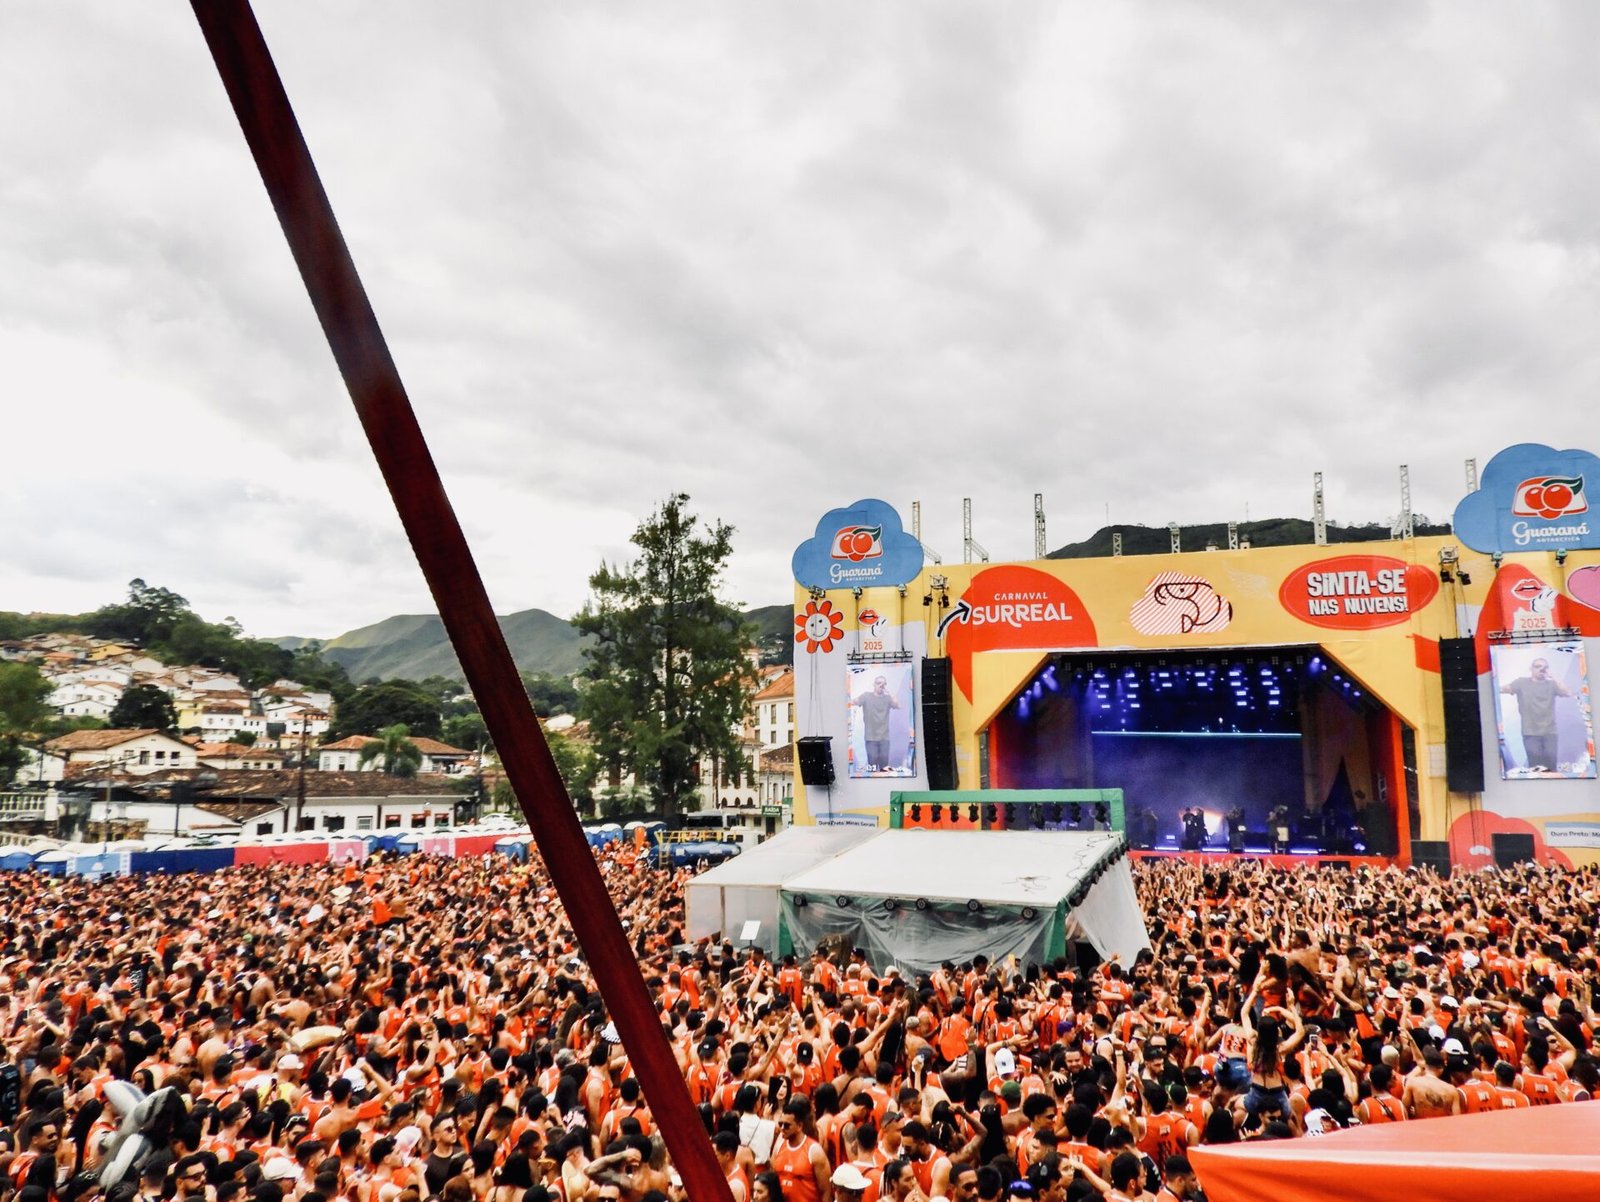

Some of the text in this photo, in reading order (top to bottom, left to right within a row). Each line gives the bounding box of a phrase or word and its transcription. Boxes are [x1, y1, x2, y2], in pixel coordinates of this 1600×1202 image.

[1512, 521, 1590, 545] Guaraná
[830, 563, 883, 584] Guaraná
[994, 592, 1048, 600] CARNAVAL
[1308, 596, 1409, 616] NAS NUVENS!
[972, 602, 1073, 628] SURREAL
[1520, 617, 1547, 628] 2025
[863, 641, 883, 650] 2025
